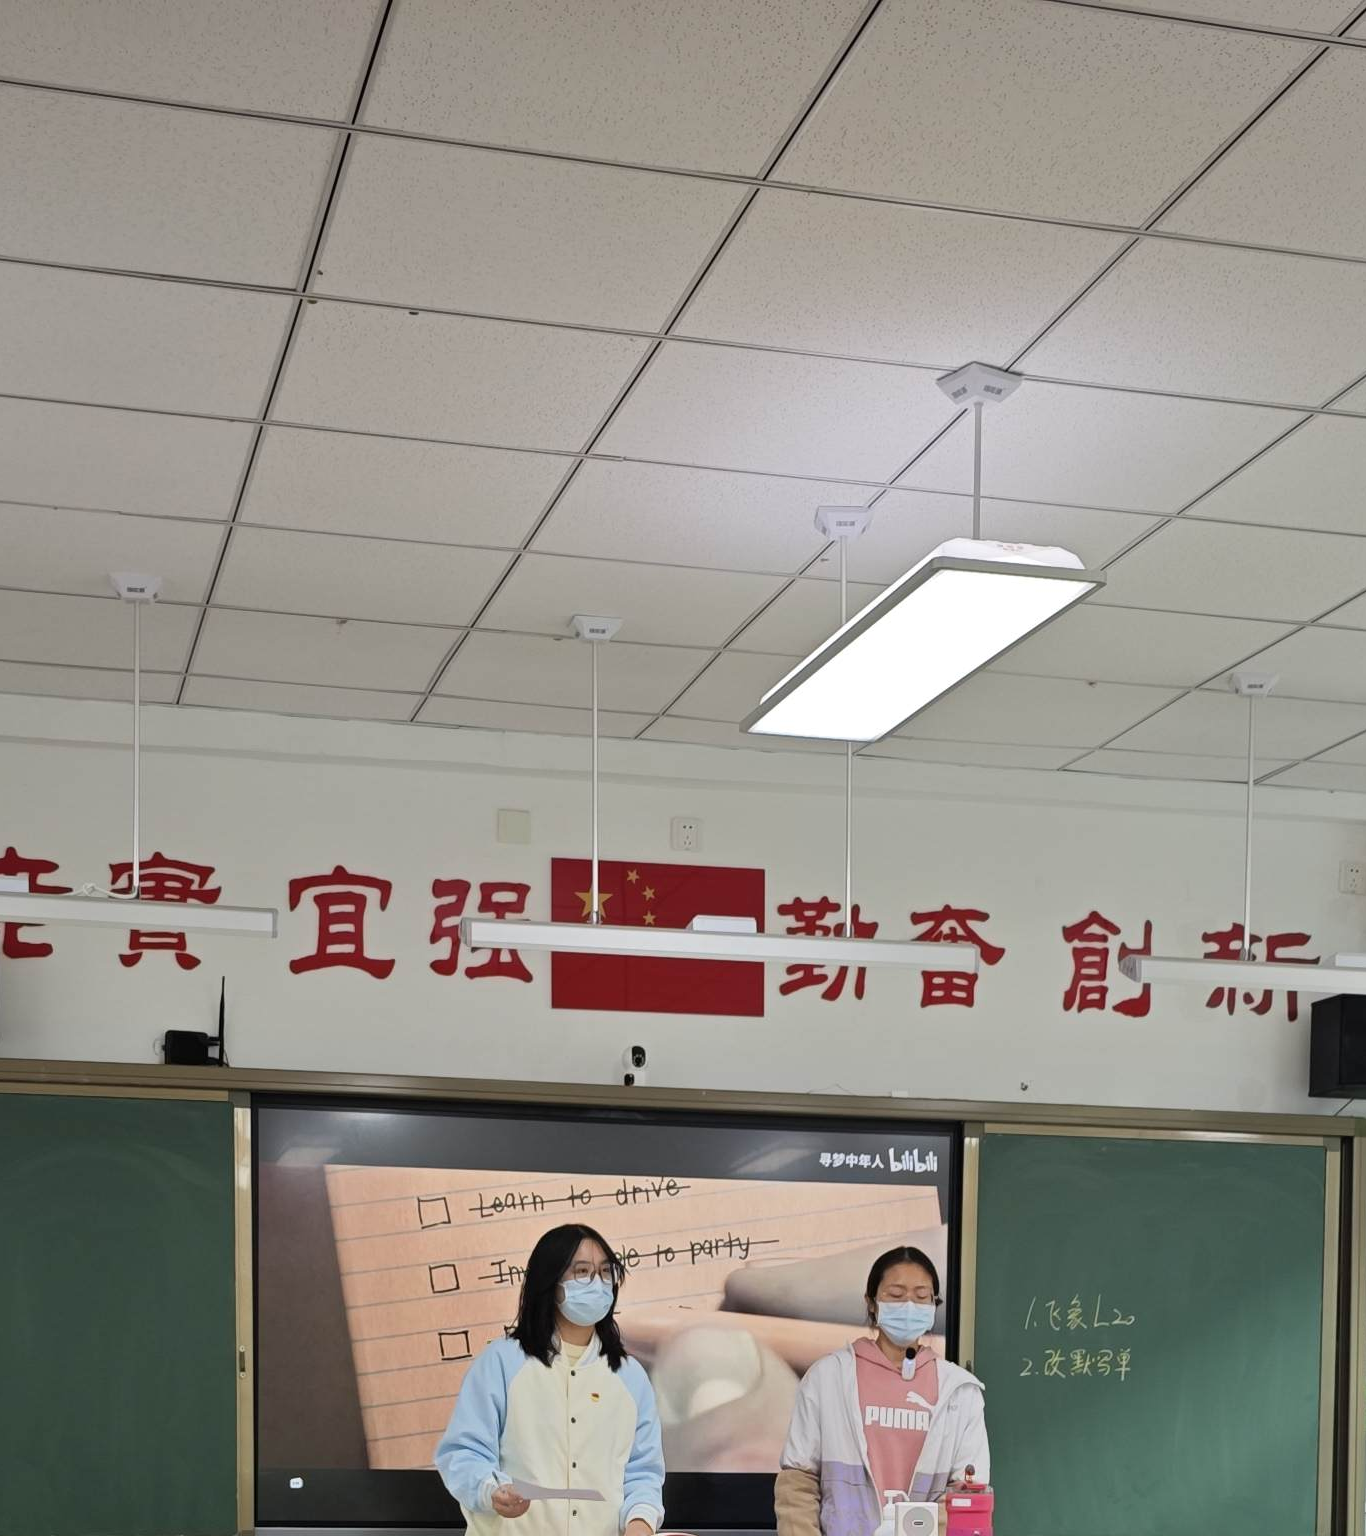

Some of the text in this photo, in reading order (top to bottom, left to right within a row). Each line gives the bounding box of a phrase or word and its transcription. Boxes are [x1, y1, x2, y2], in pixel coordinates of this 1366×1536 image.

[888, 1147, 938, 1173] bilibili
[479, 1175, 681, 1218] Learn to drive
[655, 1243, 676, 1268] to
[689, 1231, 751, 1264] party
[864, 1405, 931, 1432] PUMA
